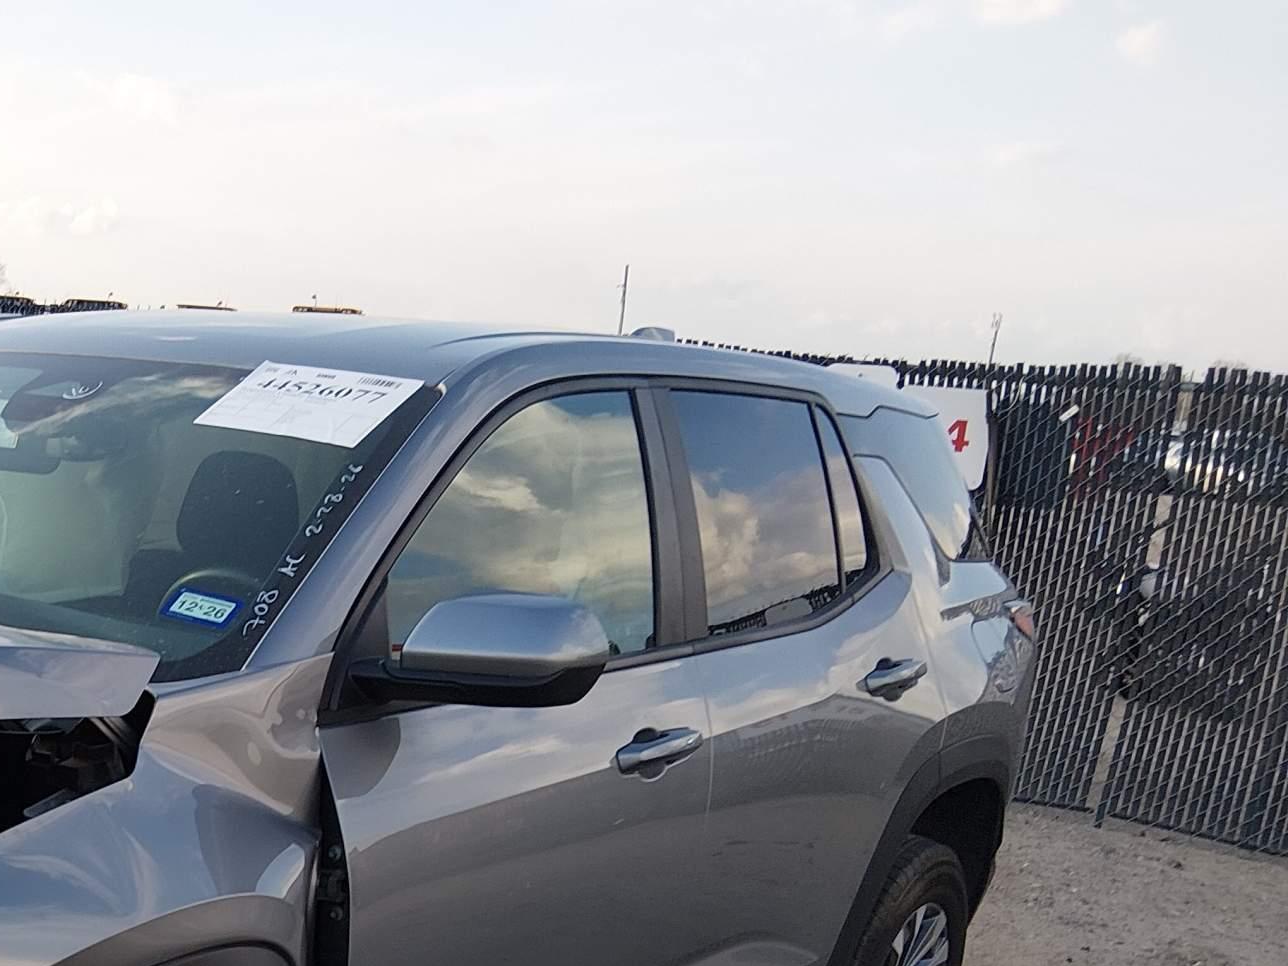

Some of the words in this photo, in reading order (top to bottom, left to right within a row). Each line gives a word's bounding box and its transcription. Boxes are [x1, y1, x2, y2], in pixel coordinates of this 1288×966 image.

[257, 378, 388, 404] 44526077
[948, 420, 969, 453] 4
[203, 605, 227, 619] 26
